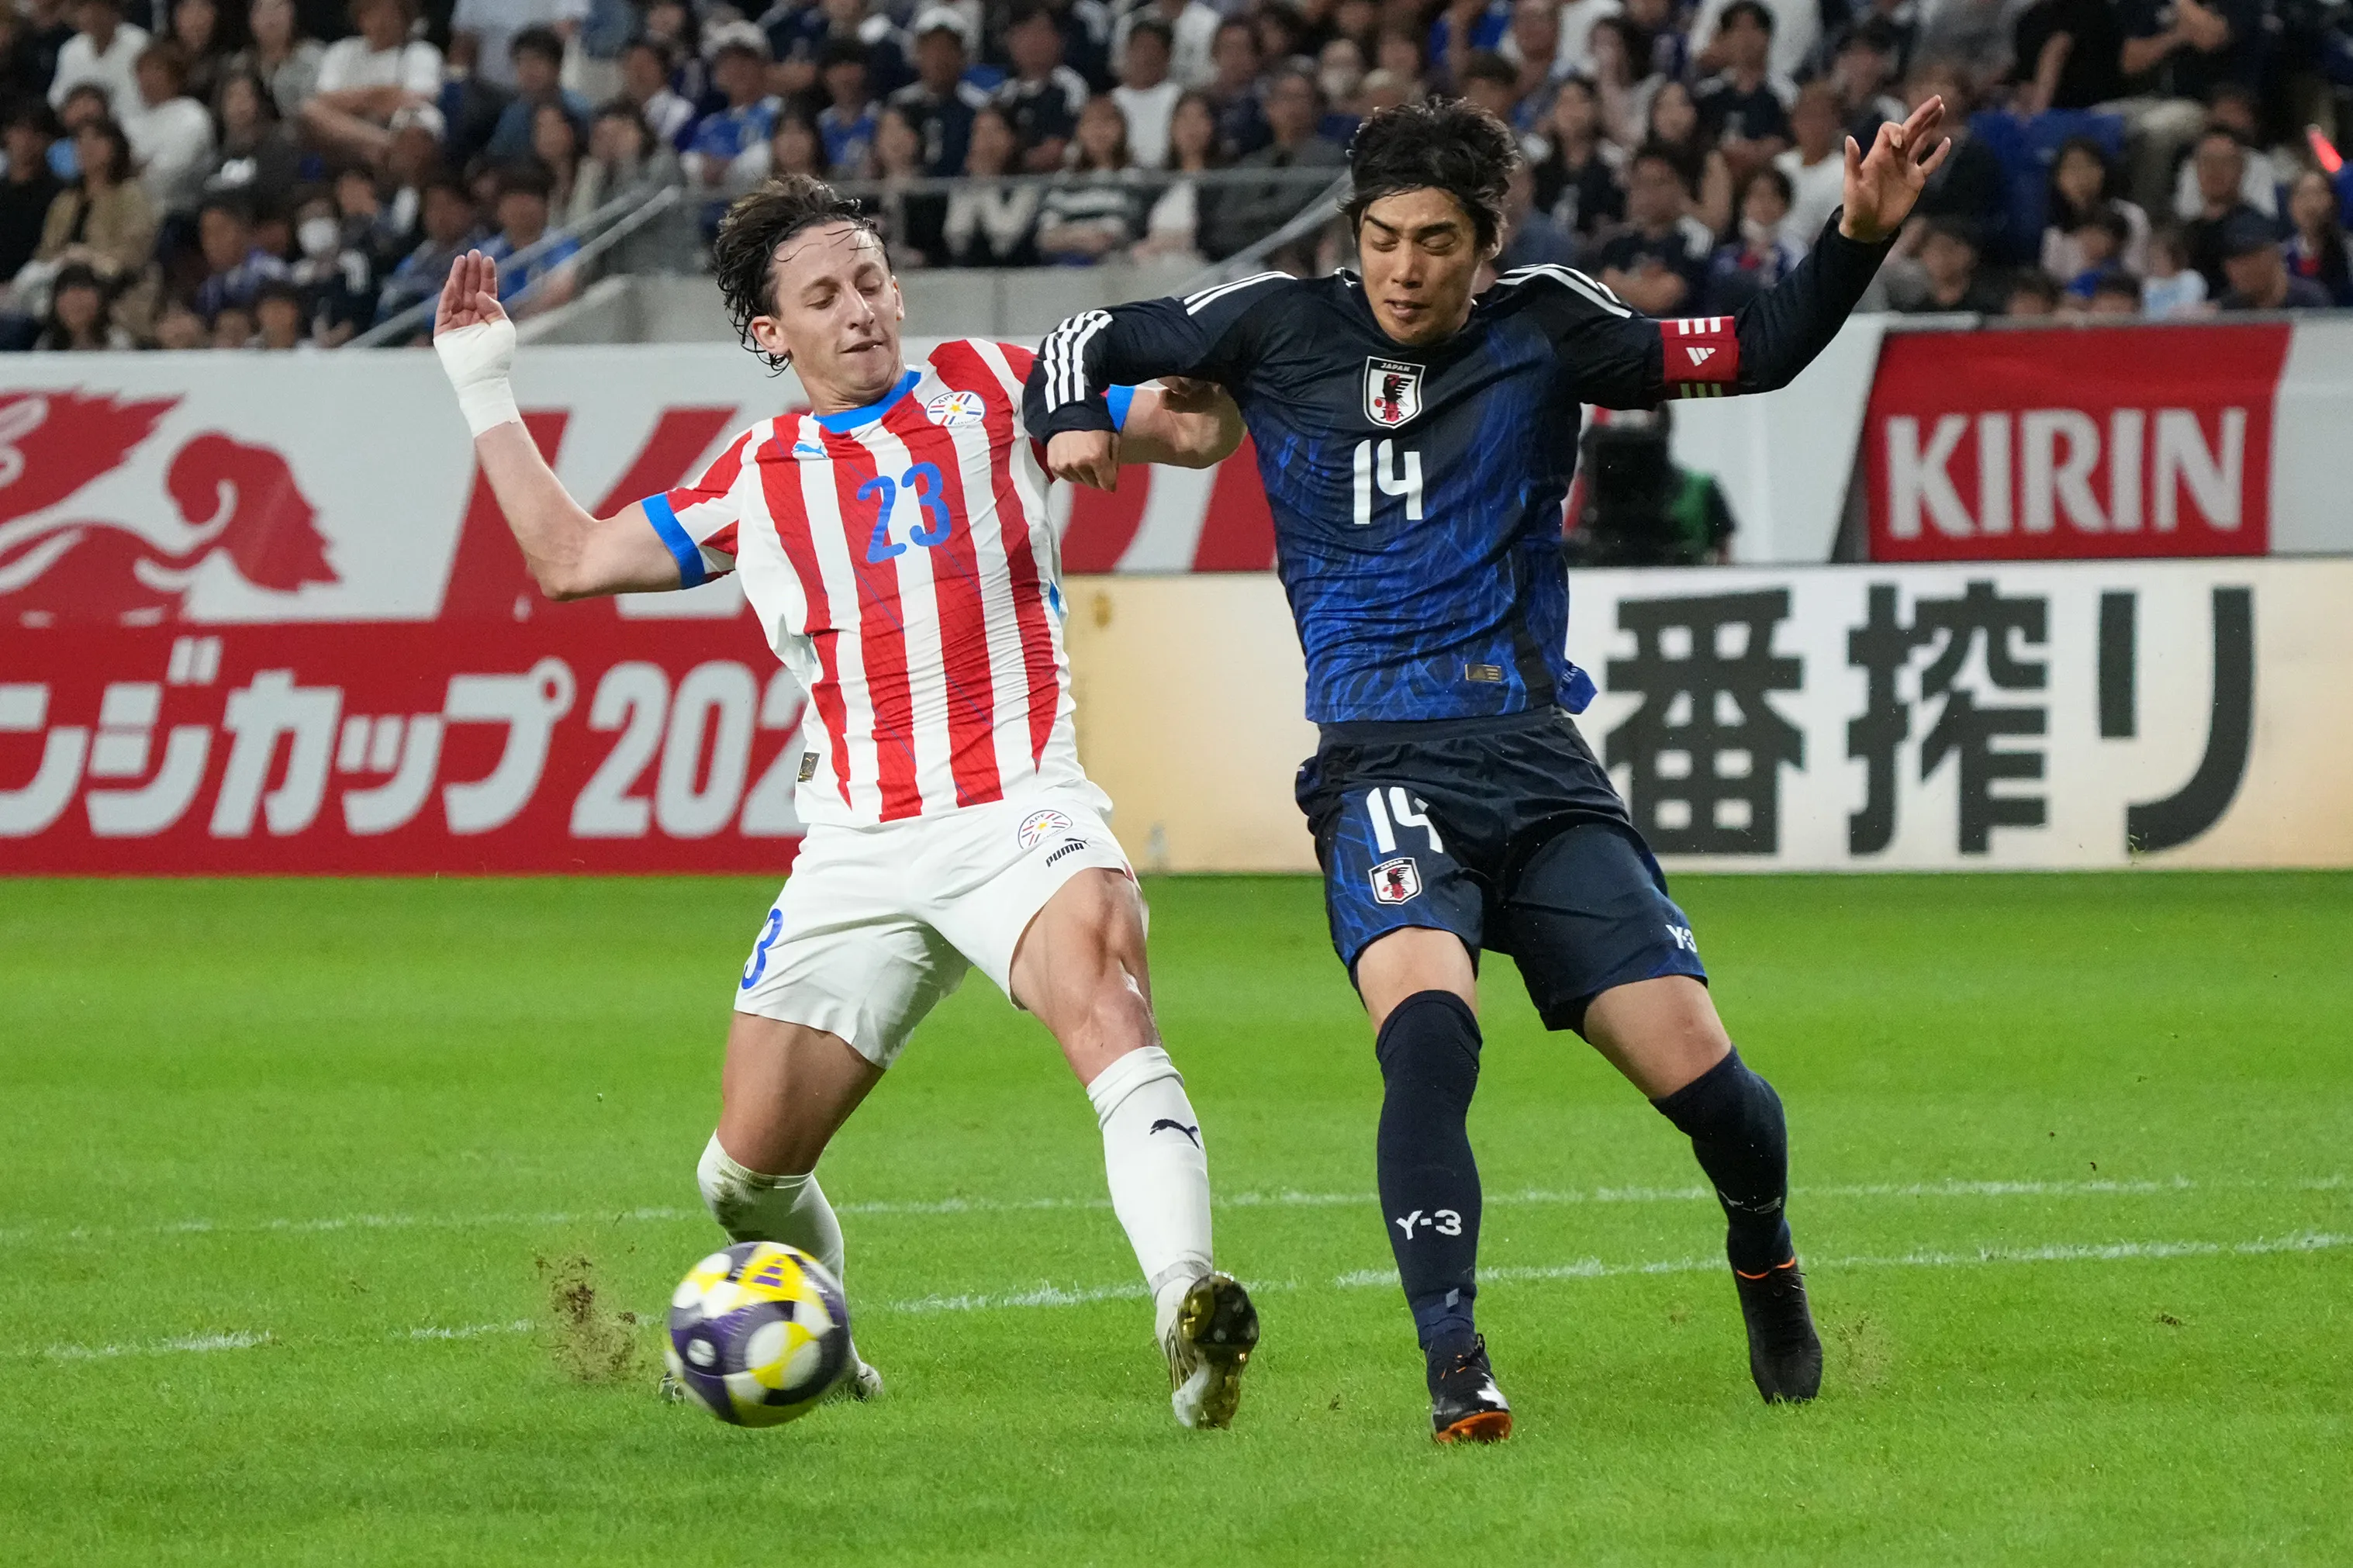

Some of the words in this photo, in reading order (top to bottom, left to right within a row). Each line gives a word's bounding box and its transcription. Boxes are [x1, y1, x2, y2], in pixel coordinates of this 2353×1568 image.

[1380, 362, 1411, 371] JAPAN
[1353, 438, 1423, 524] 14
[1886, 407, 2248, 539] KIRIN
[856, 461, 952, 564] 23
[1366, 786, 1443, 854] 14
[1045, 842, 1084, 868] PUMA
[1665, 924, 1698, 953] Y-3
[1396, 1209, 1462, 1240] Y-3
